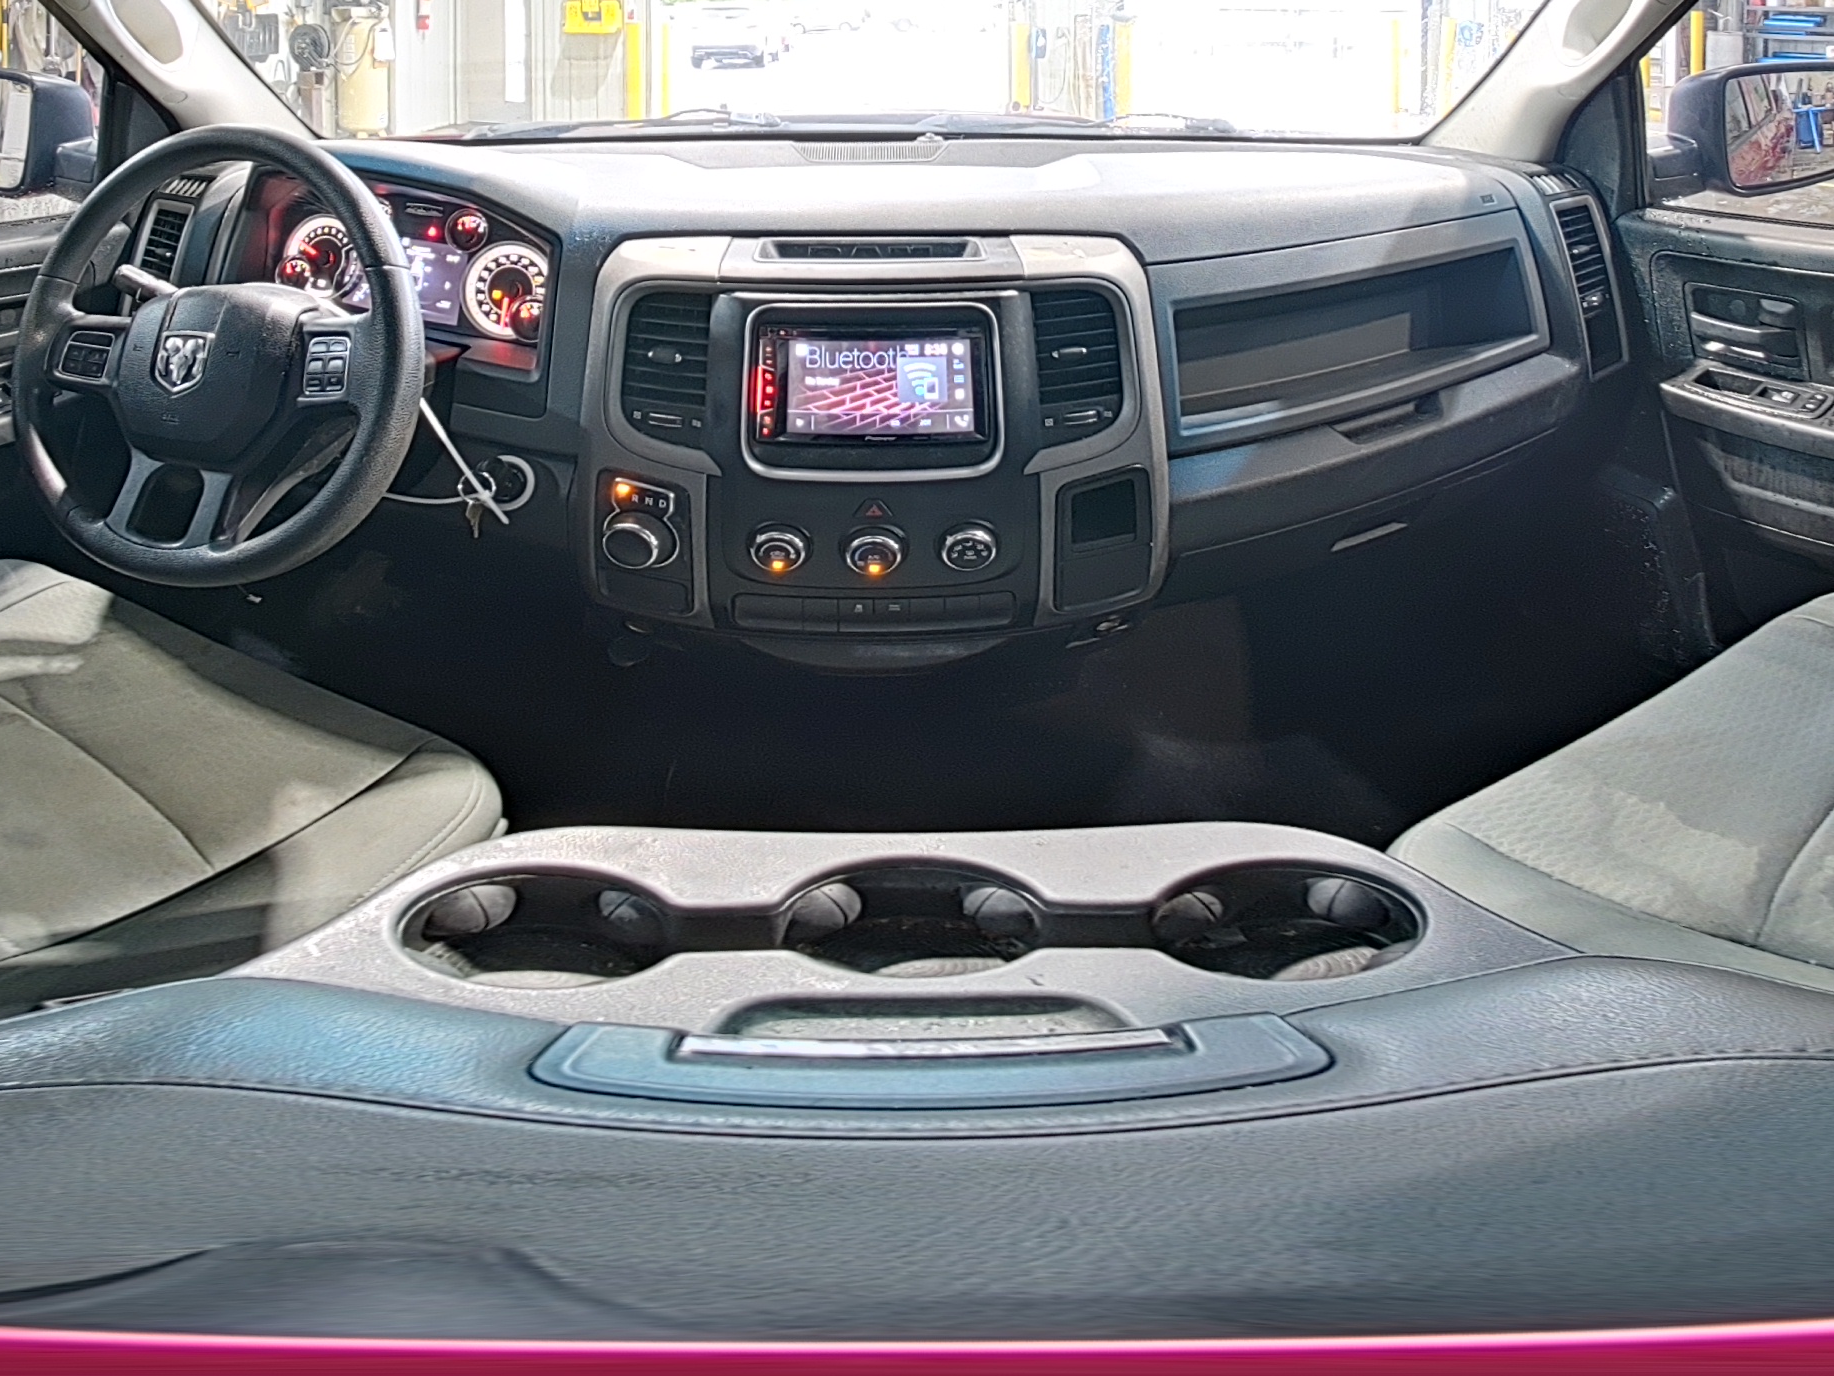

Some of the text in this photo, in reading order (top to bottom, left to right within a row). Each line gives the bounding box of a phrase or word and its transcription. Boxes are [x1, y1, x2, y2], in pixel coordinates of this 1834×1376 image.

[806, 344, 909, 369] Bluetooth
[631, 494, 667, 508] R N D
